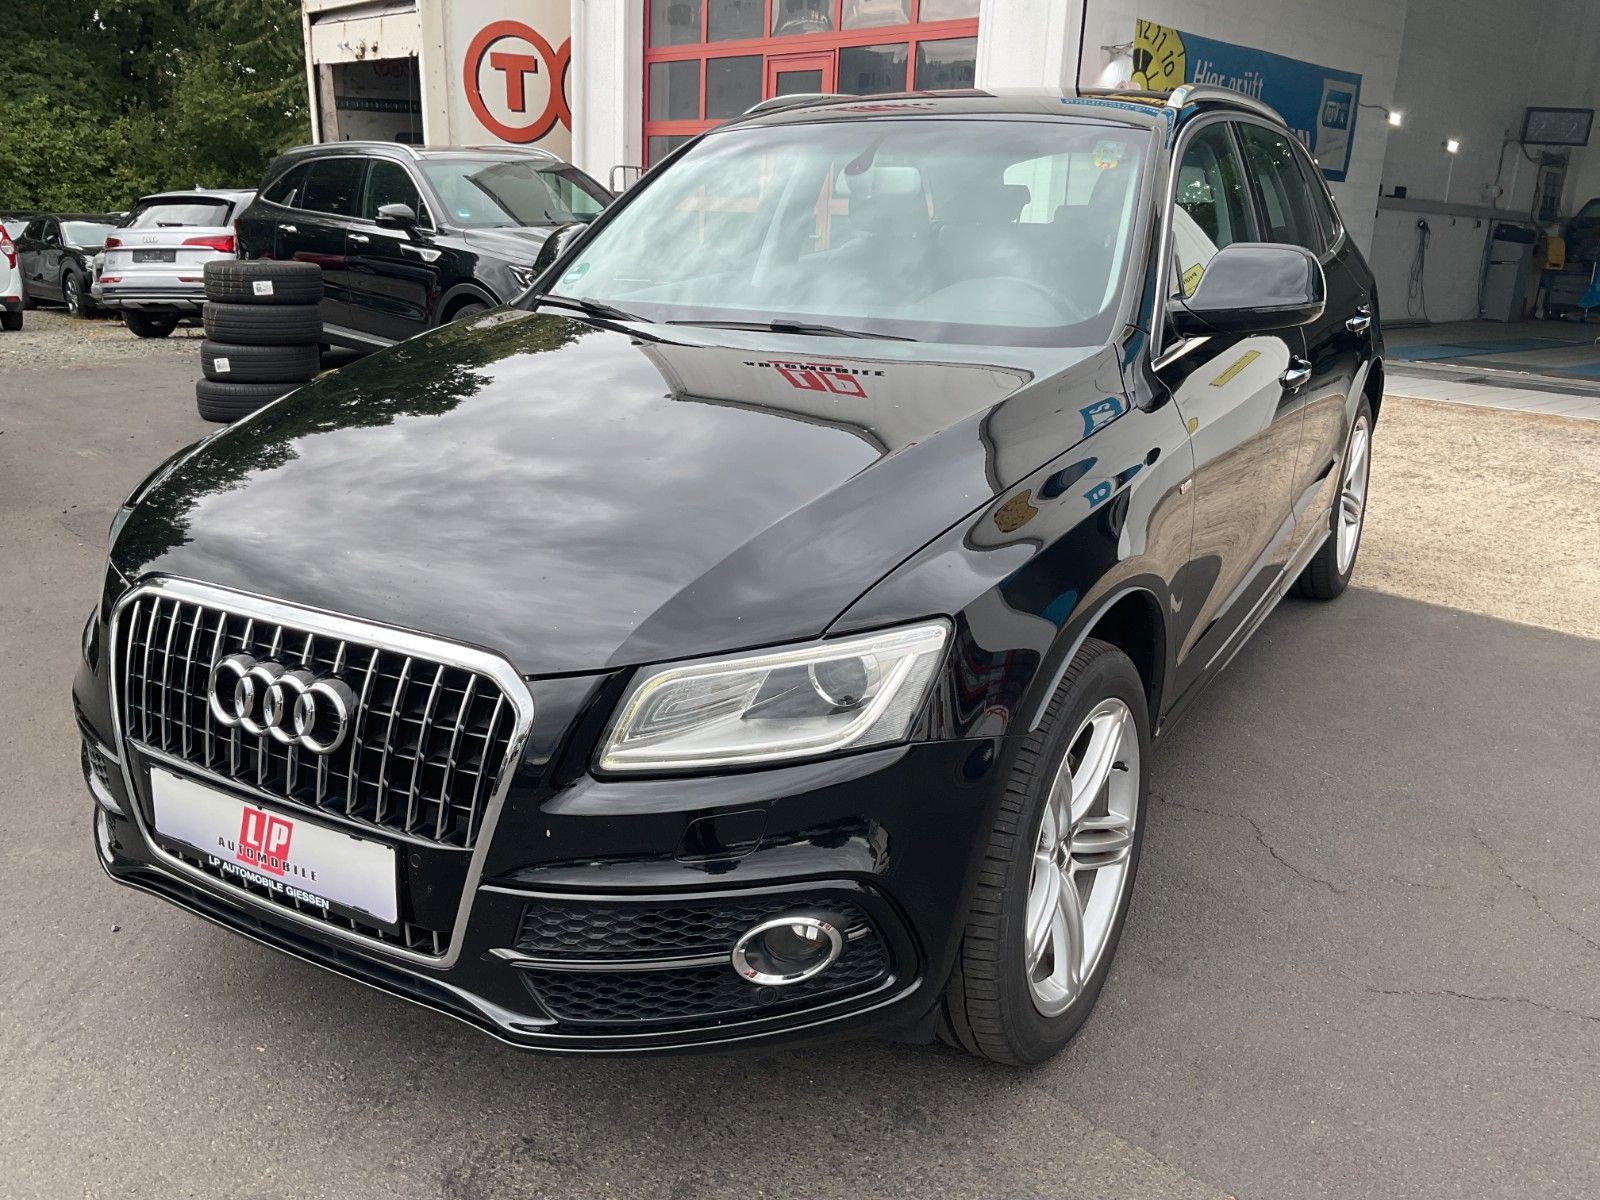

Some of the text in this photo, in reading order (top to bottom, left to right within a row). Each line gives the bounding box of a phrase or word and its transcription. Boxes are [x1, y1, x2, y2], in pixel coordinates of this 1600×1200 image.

[1161, 50, 1175, 77] 10
[218, 836, 319, 881] AUTOMOBILE
[208, 854, 331, 909] LP AUTOMOBILE GIESSEN
